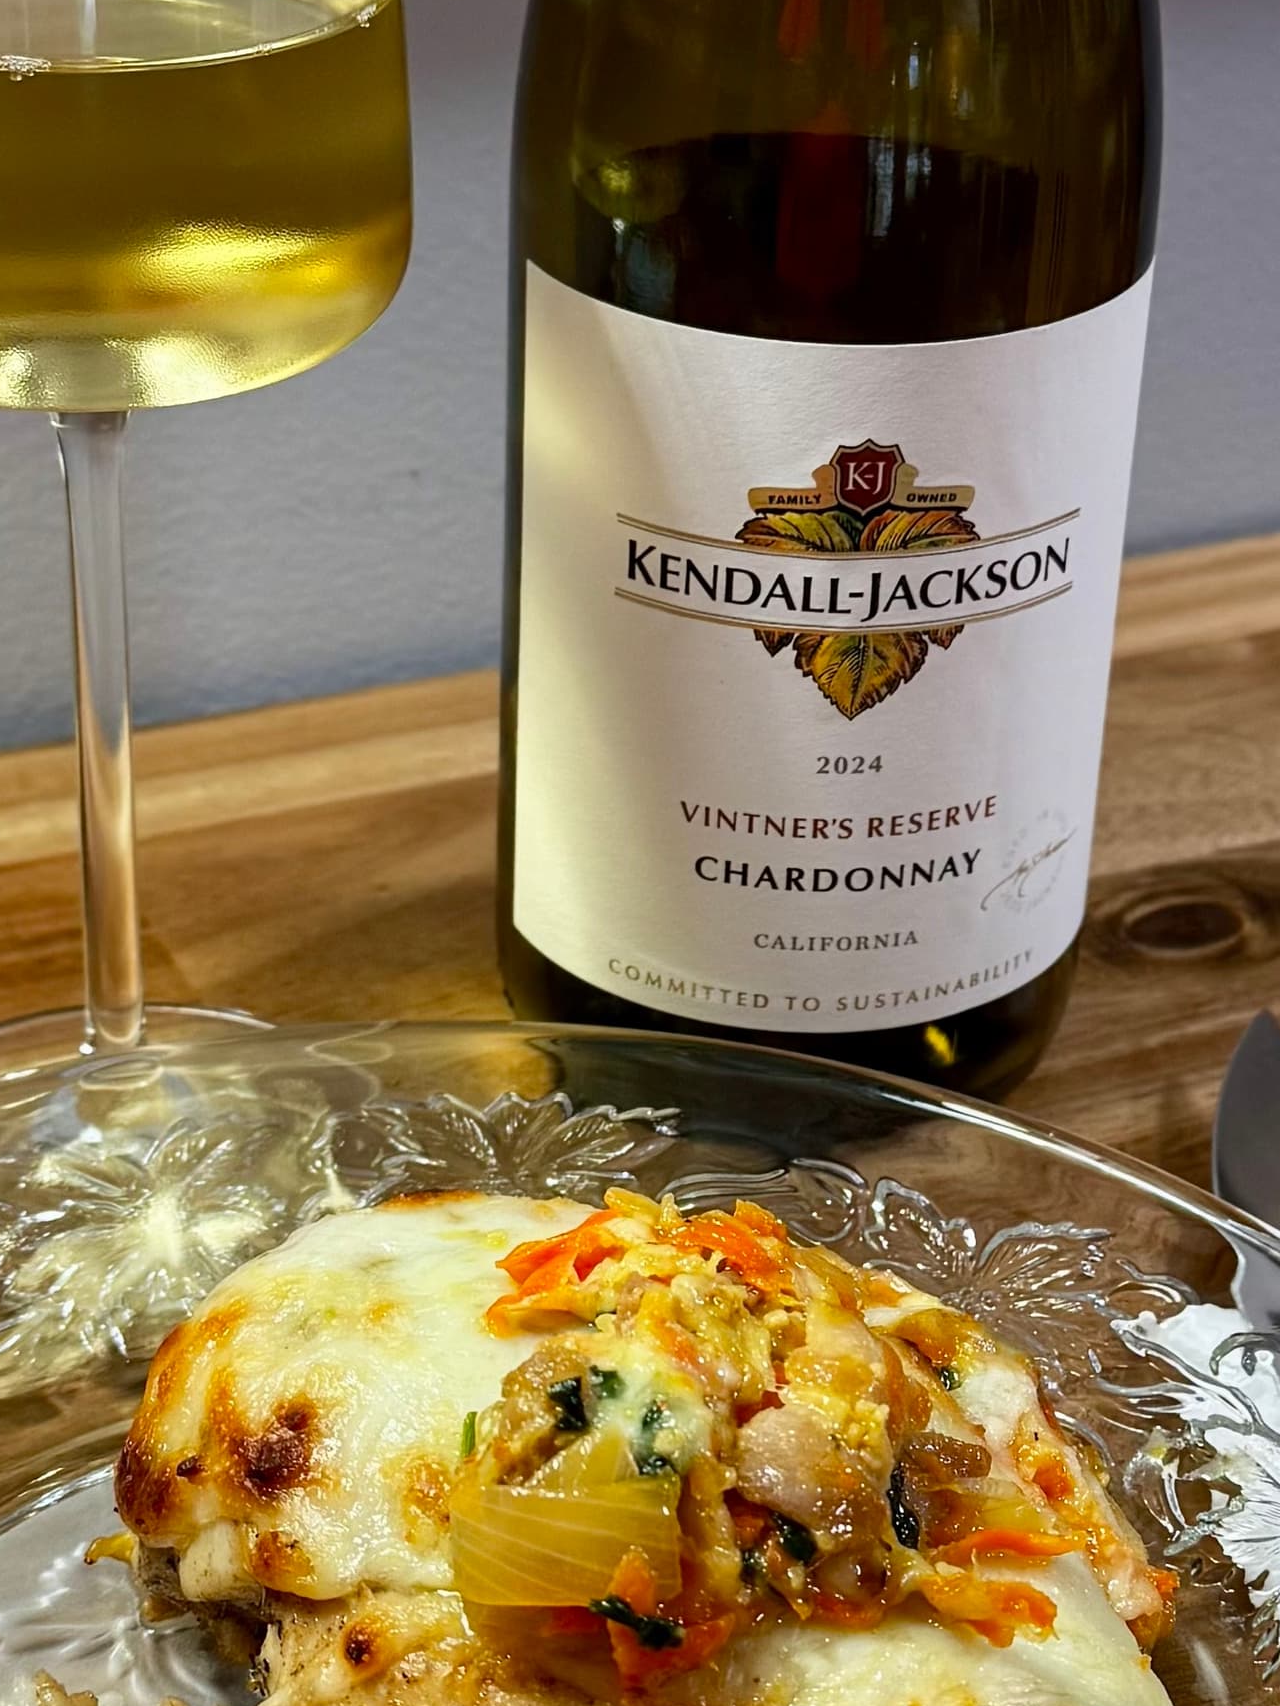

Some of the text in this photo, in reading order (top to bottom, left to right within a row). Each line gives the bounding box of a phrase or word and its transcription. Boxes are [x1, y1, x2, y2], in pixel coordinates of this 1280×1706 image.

[844, 460, 887, 496] K-J
[767, 491, 958, 506] FAMILY OWNED
[627, 536, 1071, 623] KENDALL-JACKSON
[816, 755, 884, 775] 2024
[680, 794, 998, 840] VINTNER'S RESERVE
[694, 848, 982, 893] CHARDONNAY
[753, 930, 919, 953] CALIFORNIA
[607, 948, 1035, 1012] COMMITTED TO SUSTAINABILITY
